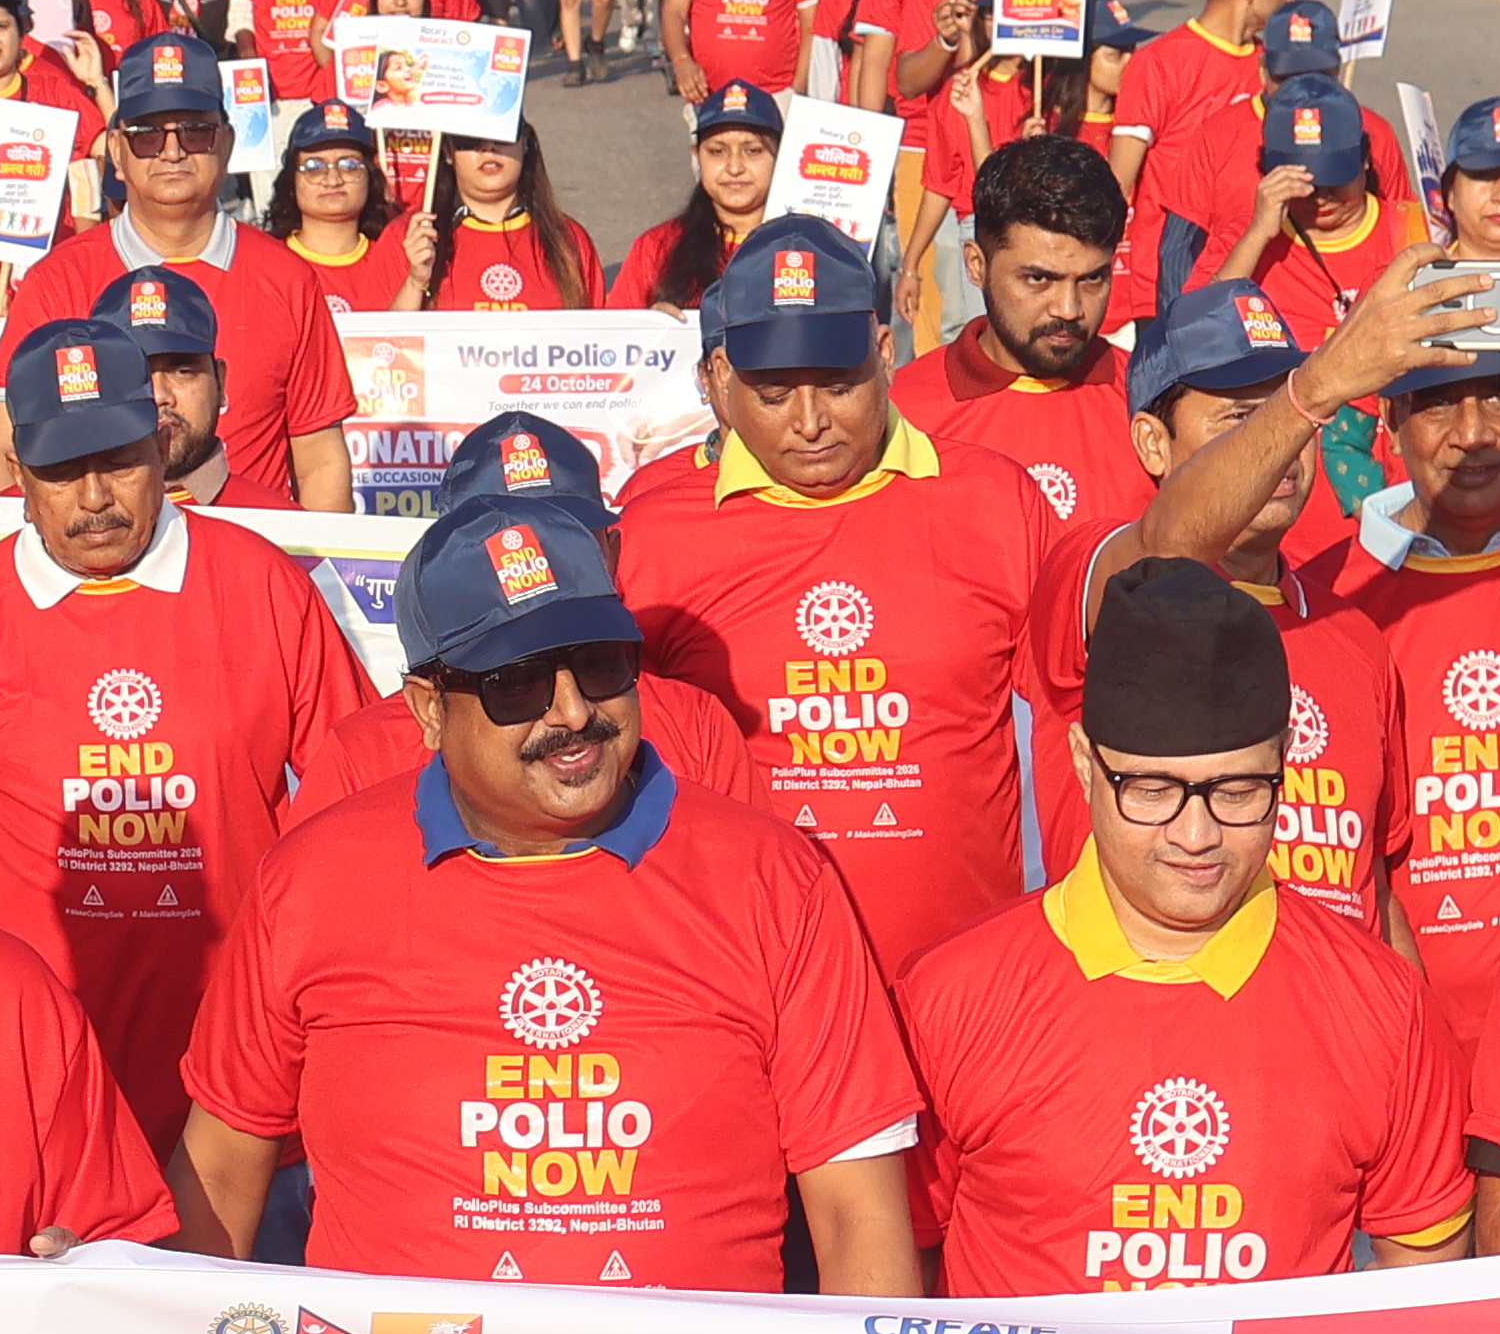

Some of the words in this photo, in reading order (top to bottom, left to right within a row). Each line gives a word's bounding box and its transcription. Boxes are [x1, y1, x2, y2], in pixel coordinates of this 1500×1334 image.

[815, 147, 860, 165] पोलियो
[458, 345, 538, 368] World
[548, 345, 616, 368] Polio
[626, 345, 676, 371] Day
[521, 377, 541, 391] 24
[546, 376, 612, 391] October
[488, 401, 539, 412] Together
[543, 402, 559, 410] we
[564, 401, 582, 409] can
[586, 399, 605, 409] end
[504, 458, 548, 475] POLIO
[509, 449, 539, 463] END
[373, 471, 441, 483] OCCASION
[510, 467, 546, 481] NOW
[79, 742, 174, 776] END
[62, 775, 196, 812] POLIO
[79, 811, 186, 845] NOW
[483, 1053, 622, 1101] END
[459, 1099, 652, 1150] POLIO
[483, 1148, 637, 1197] NOW
